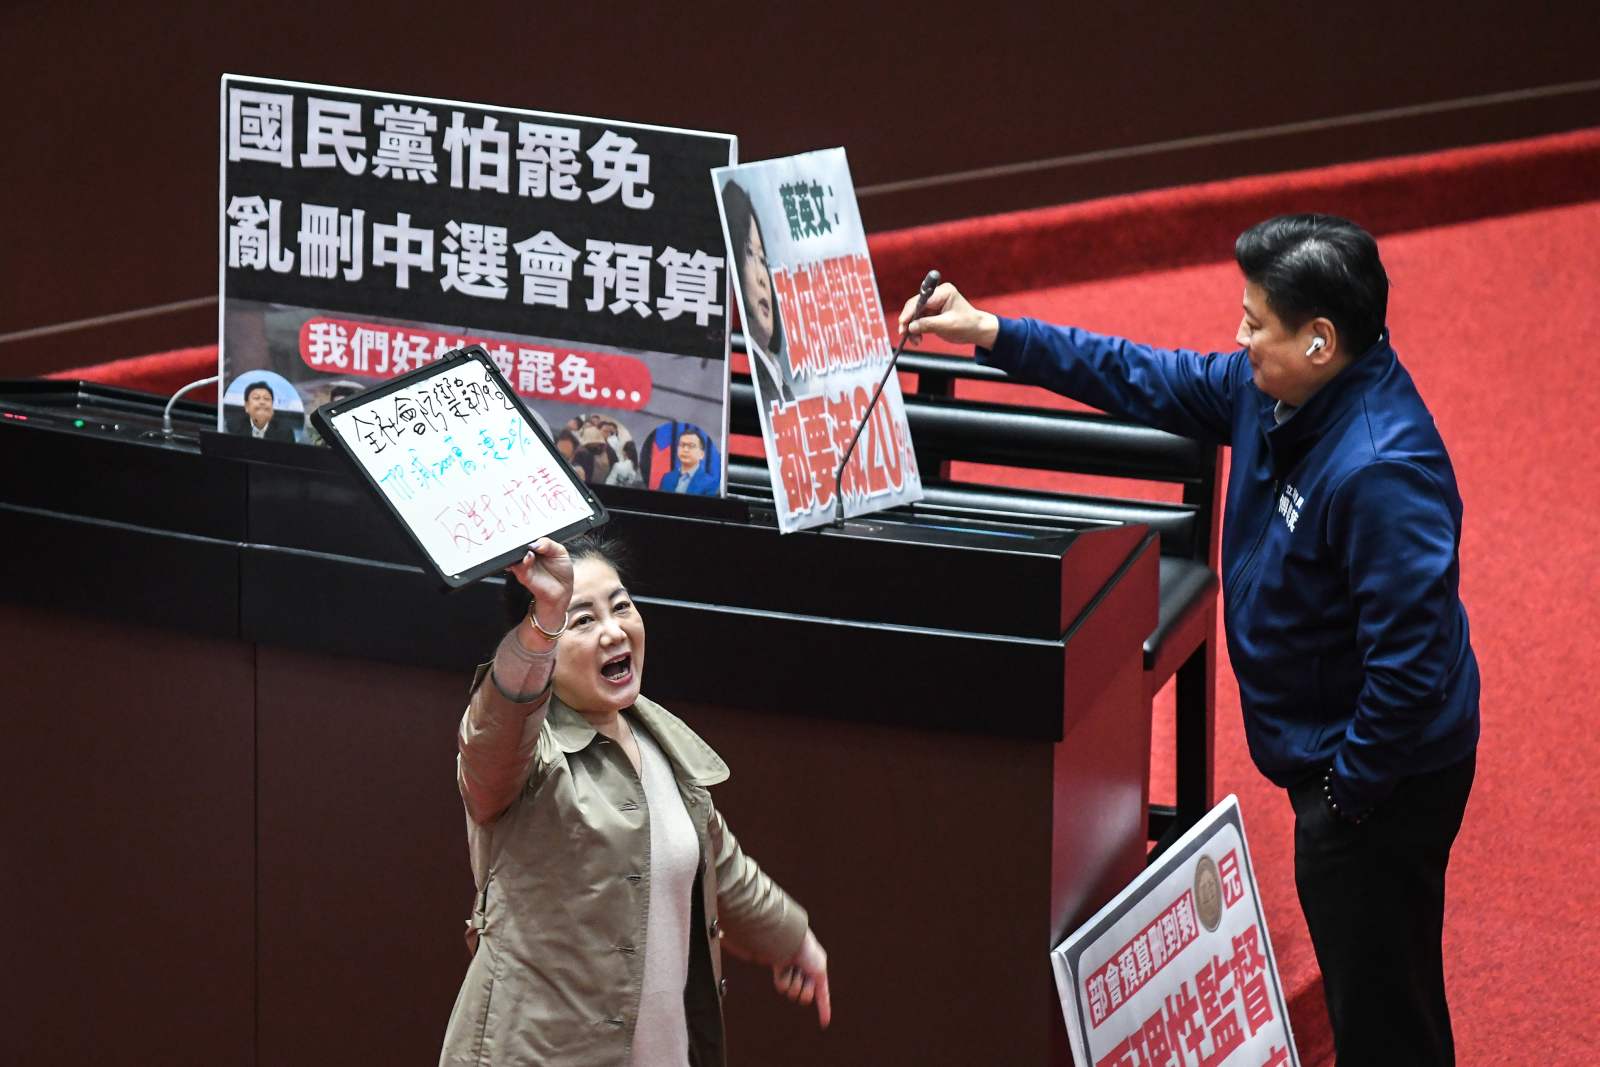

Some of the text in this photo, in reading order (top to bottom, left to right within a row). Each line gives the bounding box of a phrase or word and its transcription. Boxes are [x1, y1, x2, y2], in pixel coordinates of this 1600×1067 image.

[227, 88, 656, 210] 國民黨怕罷免
[226, 195, 725, 327] 亂刪中選會預算
[773, 255, 892, 378] 政府機關預算
[770, 382, 917, 515] 都要減20%
[1088, 856, 1241, 1025] 部會預算刪到剩 元
[1096, 923, 1275, 1067] 理性監督
